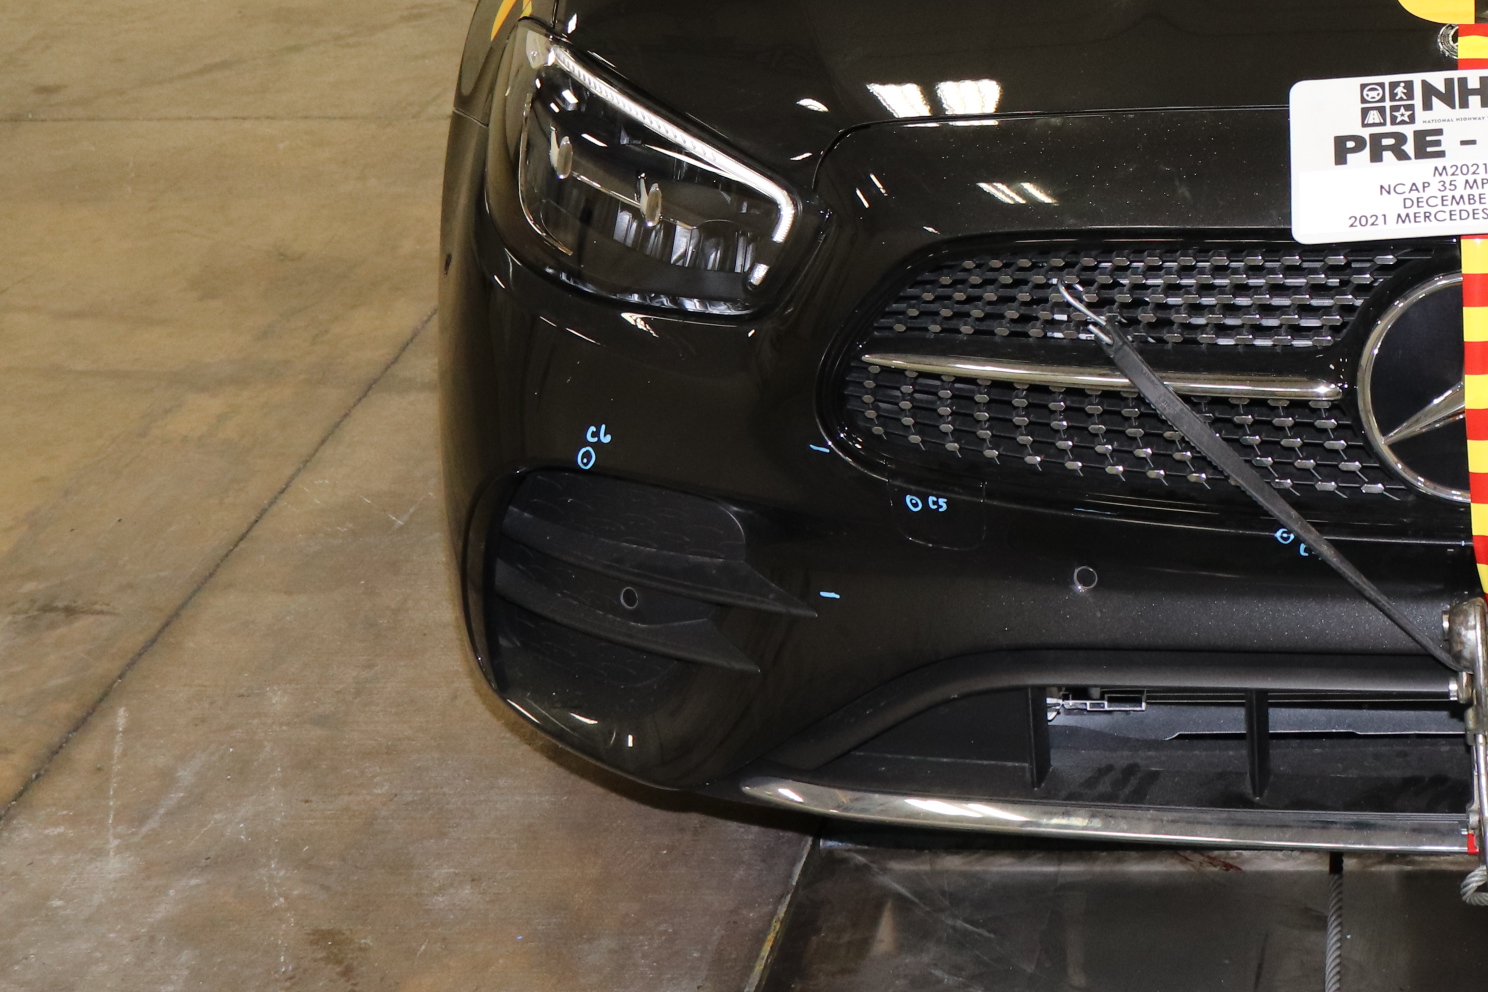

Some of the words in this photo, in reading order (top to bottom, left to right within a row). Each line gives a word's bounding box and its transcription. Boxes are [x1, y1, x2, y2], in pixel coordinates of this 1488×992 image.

[1333, 128, 1446, 166] PRE
[1379, 182, 1431, 196] NCAP
[1437, 180, 1458, 192] 35
[1348, 214, 1388, 228] 2021
